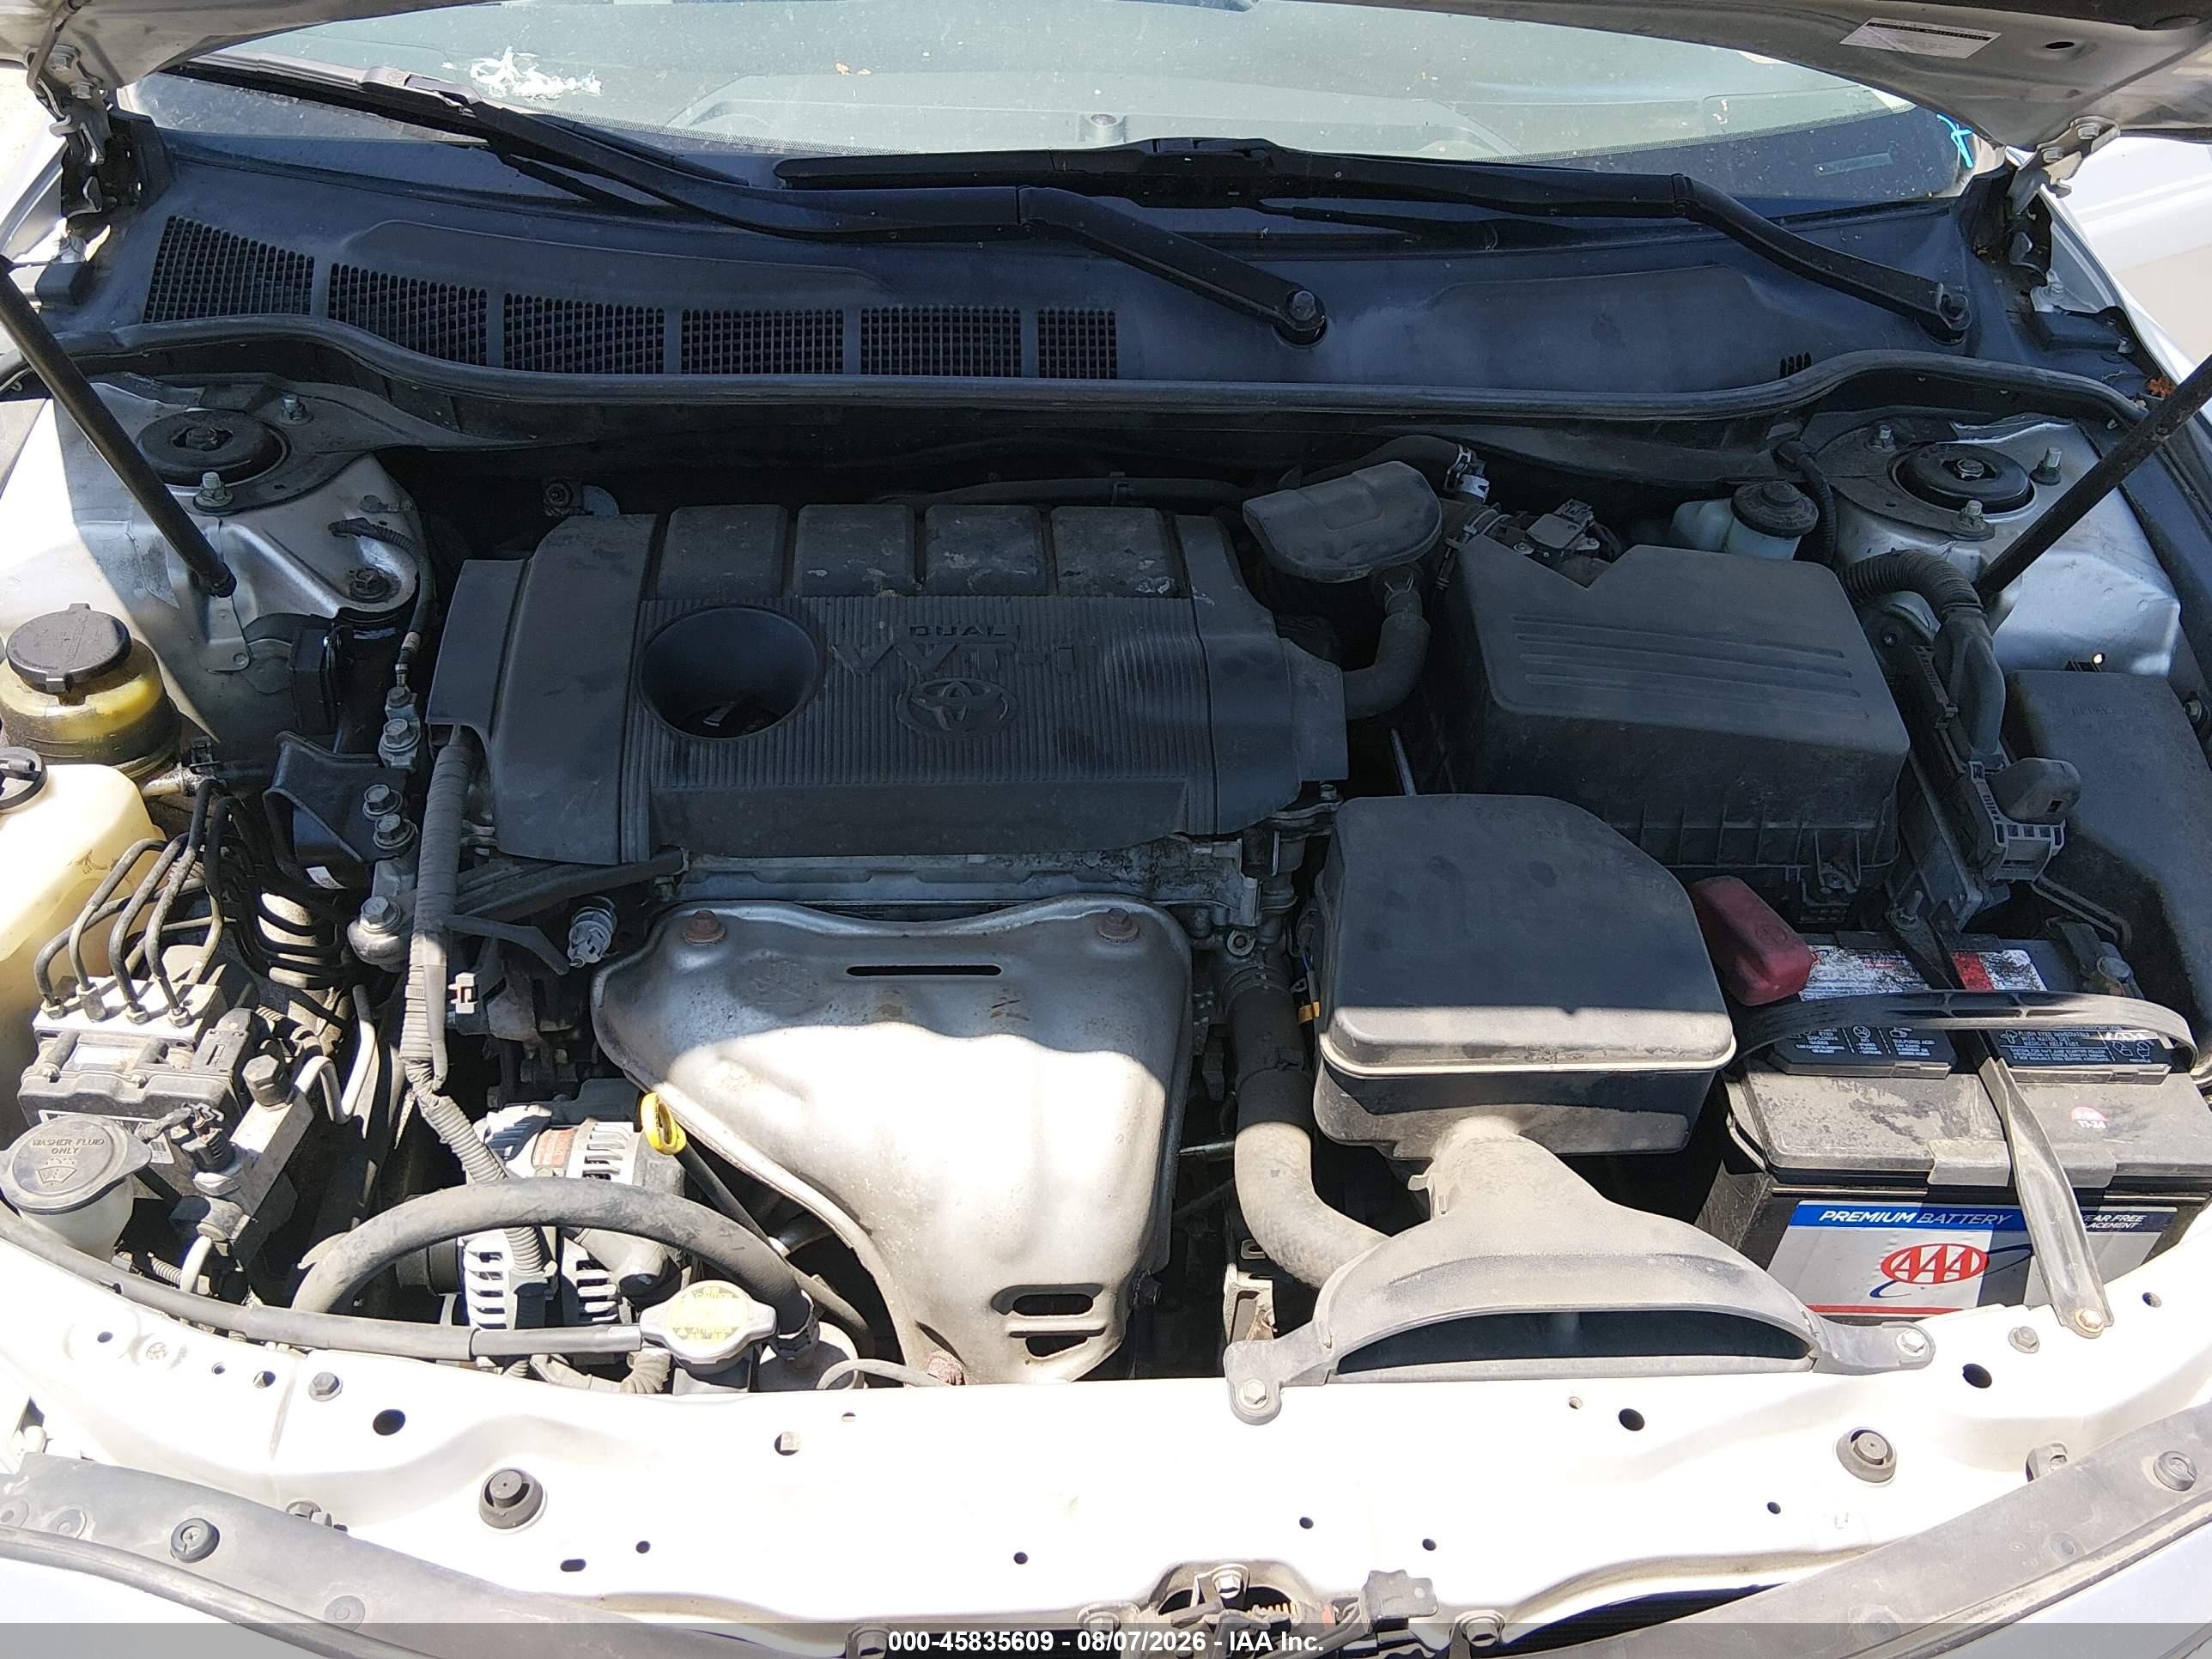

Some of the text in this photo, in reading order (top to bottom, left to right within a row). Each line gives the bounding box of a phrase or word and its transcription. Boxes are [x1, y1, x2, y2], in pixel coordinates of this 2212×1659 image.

[909, 625, 1007, 636] DUAL
[76, 1138, 106, 1146] FLUID
[50, 1146, 80, 1155] ONLY
[1819, 1210, 2014, 1225] PREMIUM BATTERY
[1892, 1244, 1977, 1283] AAA
